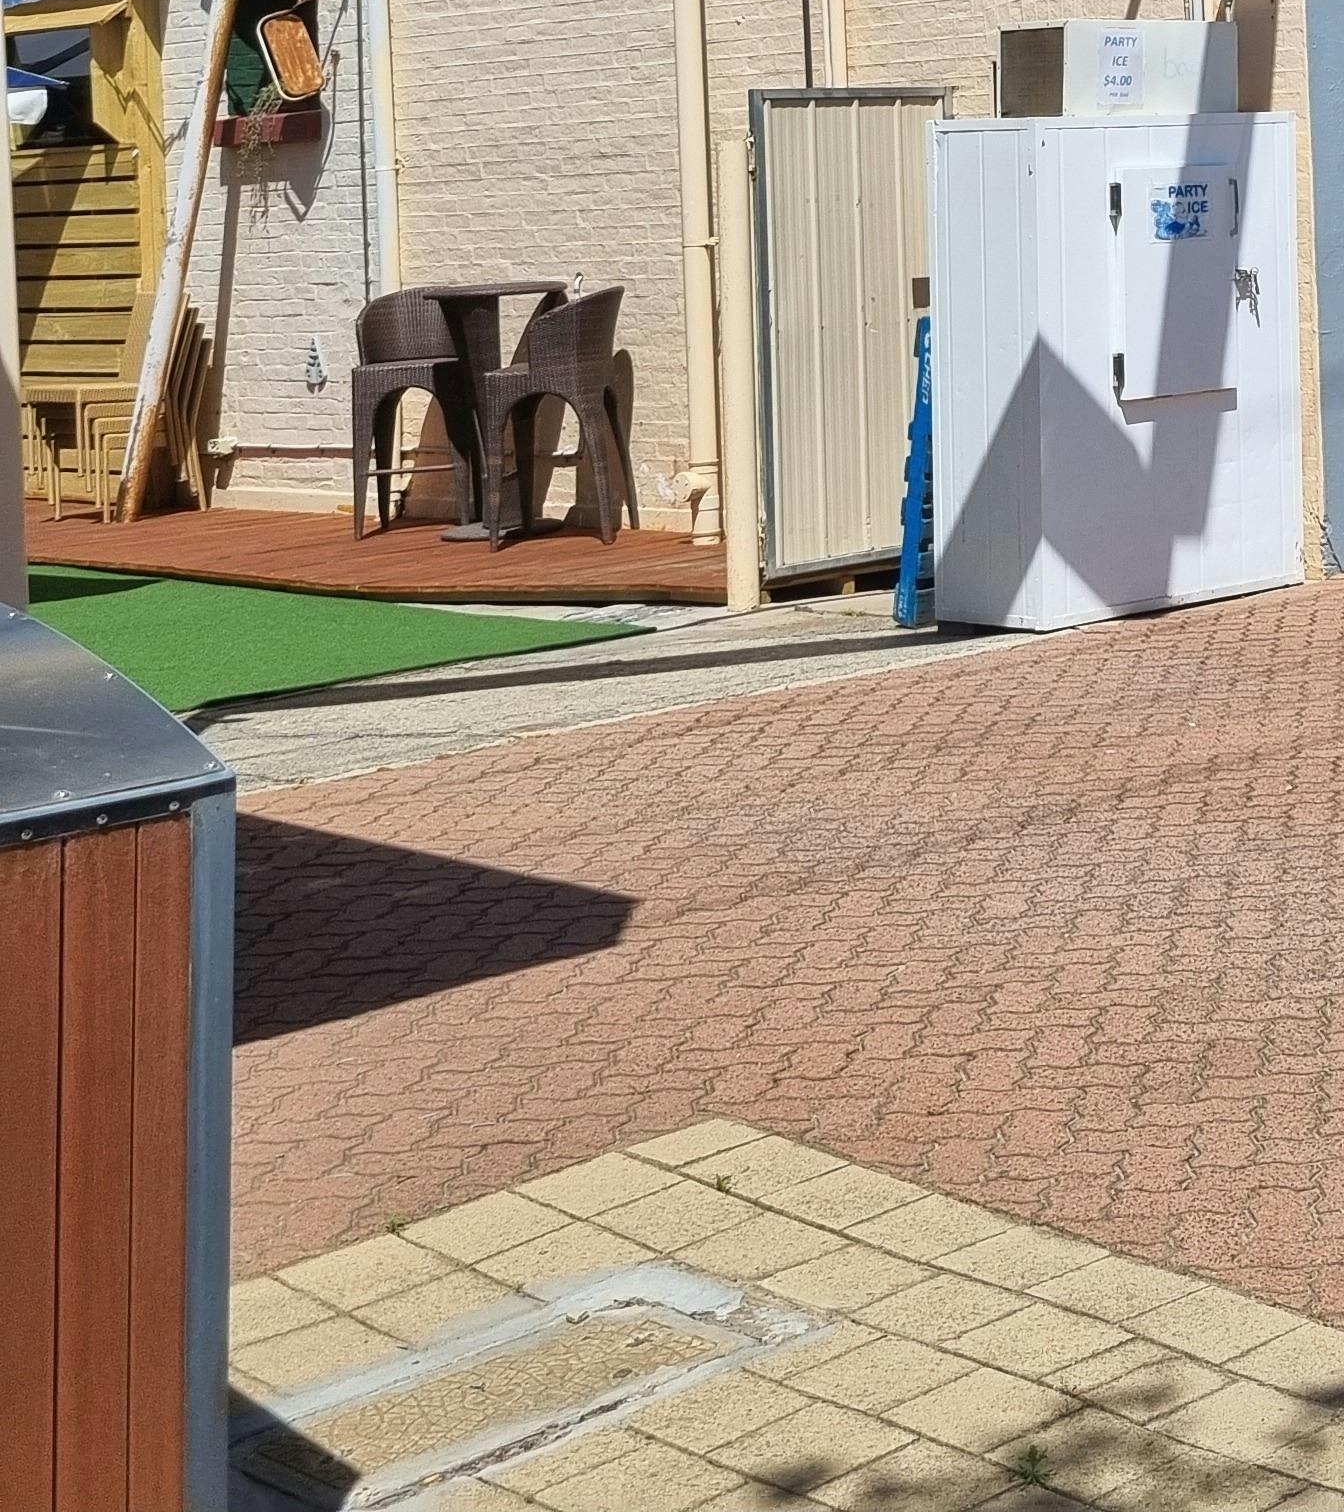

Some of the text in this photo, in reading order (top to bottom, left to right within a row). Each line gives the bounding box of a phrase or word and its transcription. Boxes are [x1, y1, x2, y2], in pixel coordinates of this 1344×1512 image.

[1104, 36, 1138, 47] PARTY
[1112, 56, 1129, 66] ICE
[1104, 75, 1132, 87] $4.00
[1168, 184, 1208, 198] PARTY
[1188, 201, 1209, 214] ICE
